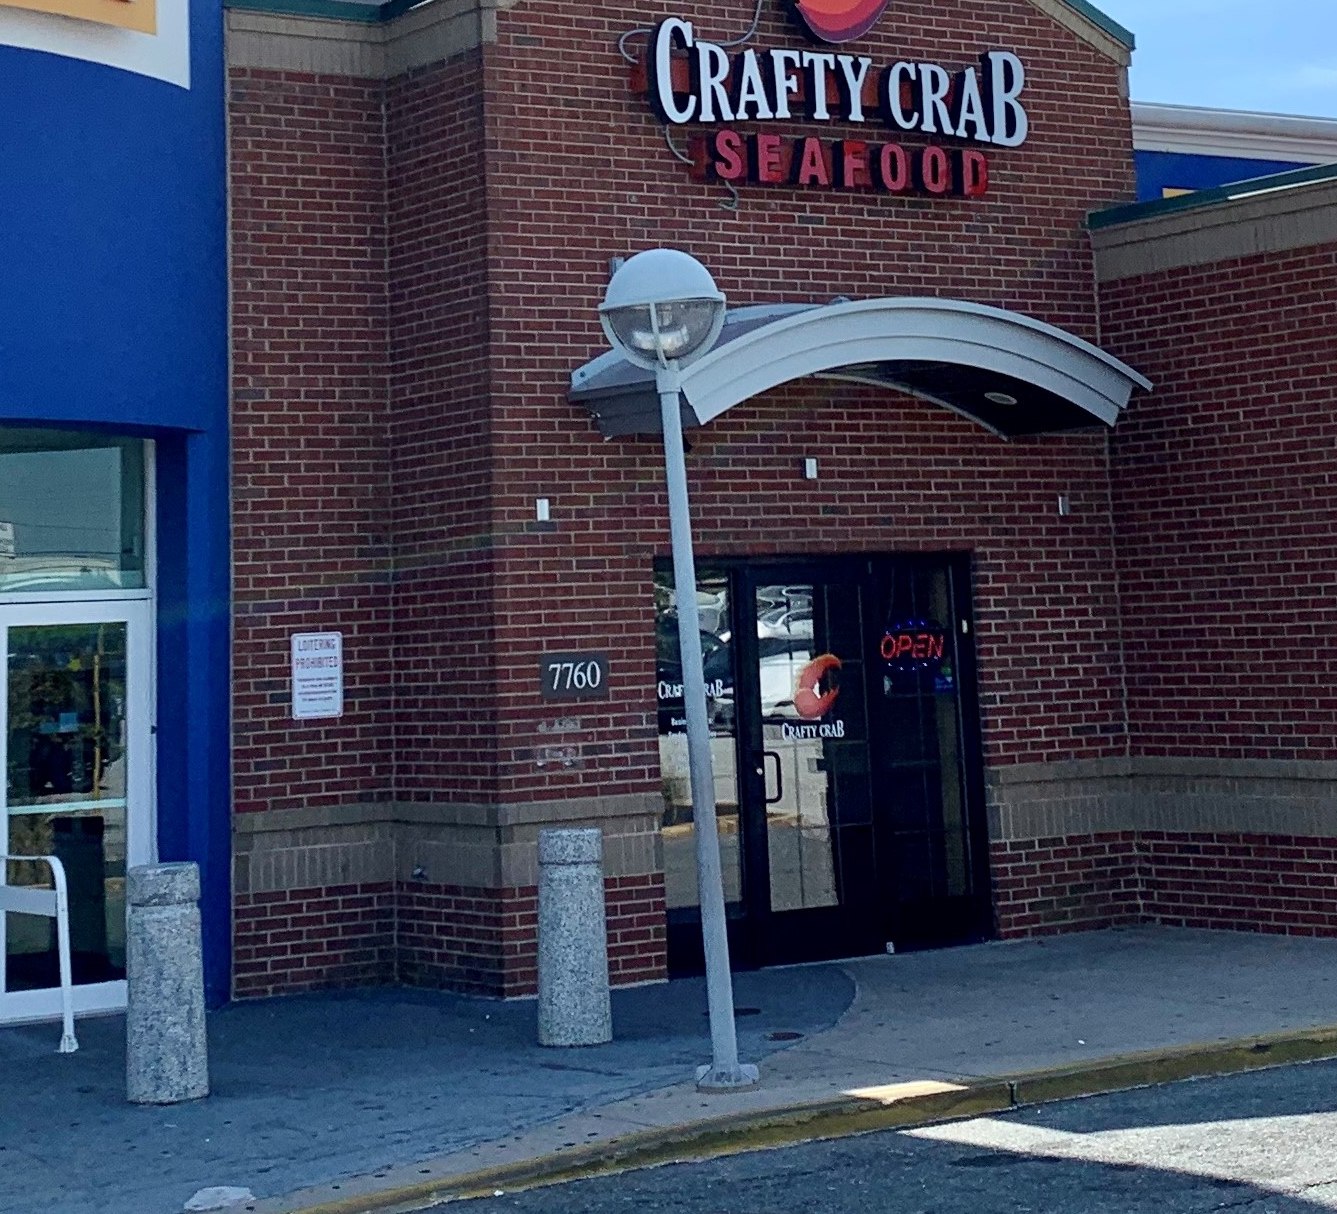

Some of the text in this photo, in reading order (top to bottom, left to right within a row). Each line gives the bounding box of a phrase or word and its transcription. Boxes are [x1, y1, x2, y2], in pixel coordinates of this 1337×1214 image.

[655, 16, 1029, 148] CRAFTY CRAB
[714, 129, 990, 197] SEAFOOD
[880, 633, 945, 659] OPEN
[296, 655, 338, 669] PROHIBITED
[548, 660, 602, 691] 7760
[657, 678, 724, 700] CRAF RAB
[781, 719, 845, 741] CRAFTY CRAB
